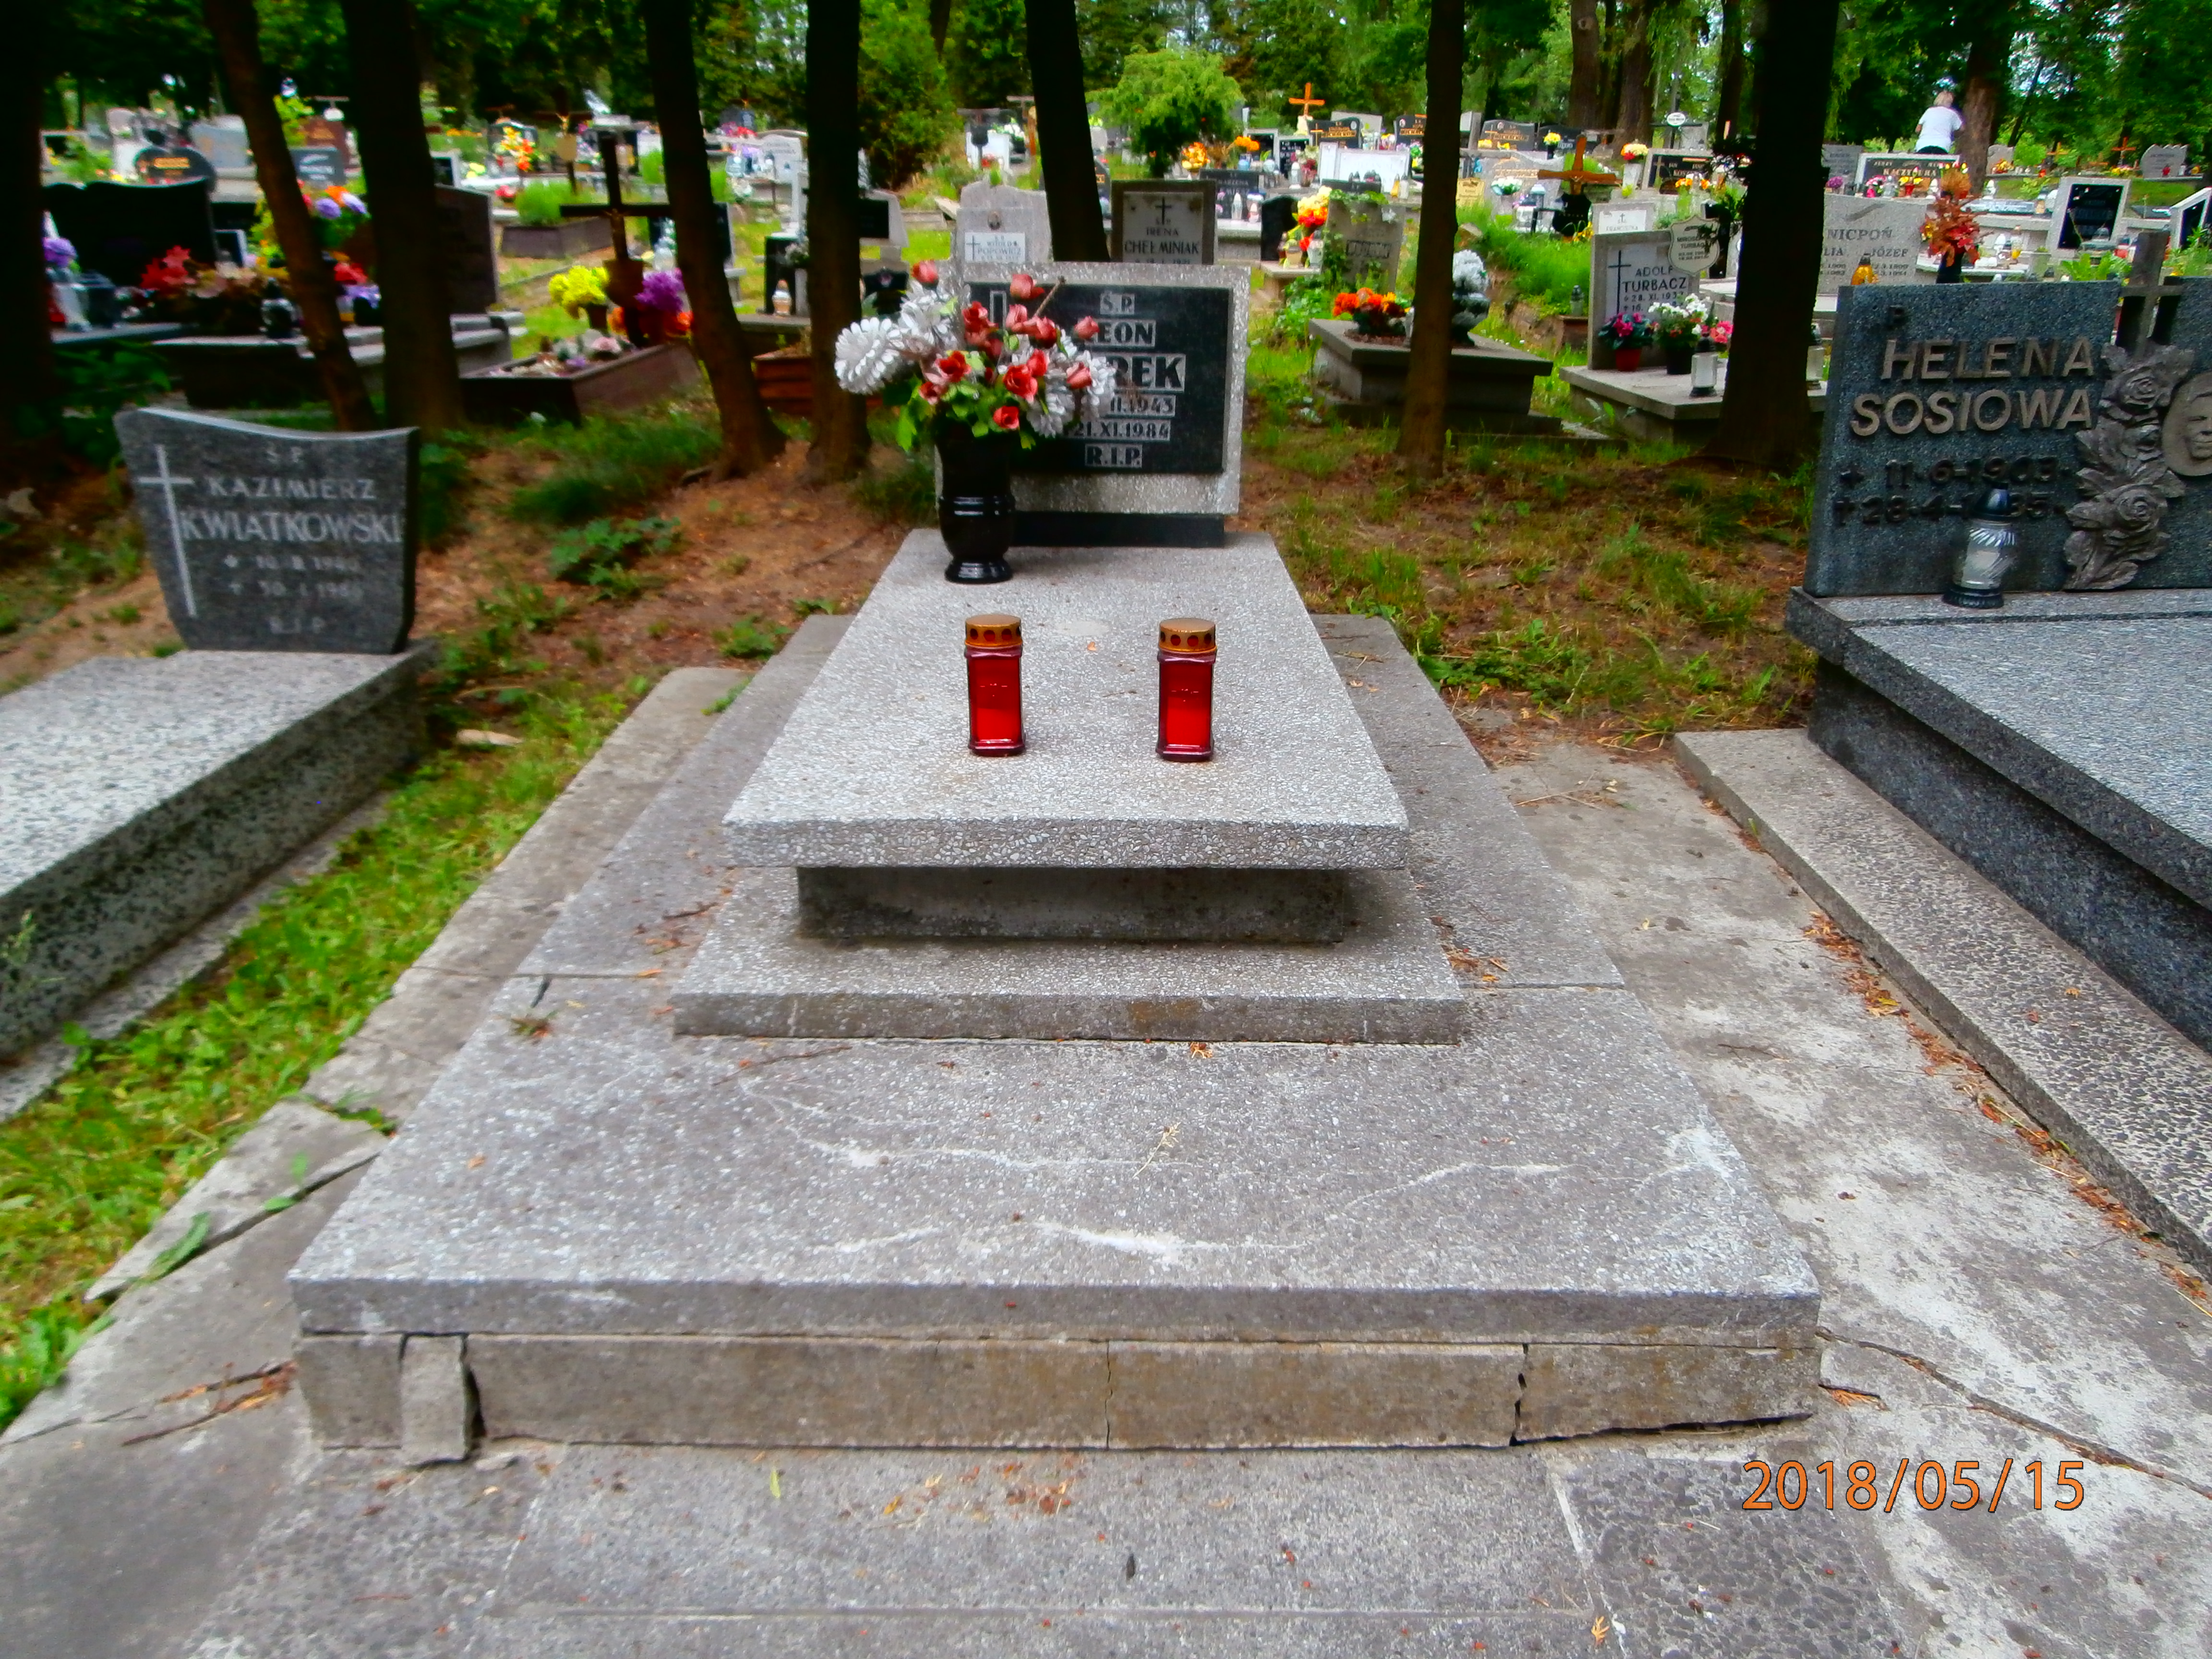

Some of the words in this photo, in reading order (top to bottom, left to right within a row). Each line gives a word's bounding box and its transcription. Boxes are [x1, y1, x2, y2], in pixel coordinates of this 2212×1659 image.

[1146, 227, 1179, 236] IRENA
[1827, 226, 1893, 240] NICPOŃ
[1622, 277, 1687, 293] TURBACZ
[1880, 336, 2095, 379] HELENA
[1851, 389, 2092, 436] SOSIOWA
[1086, 445, 1141, 466] R.I.P.
[207, 477, 375, 499] KAZIMIERZ
[181, 509, 405, 542] KWIATKOWSKI
